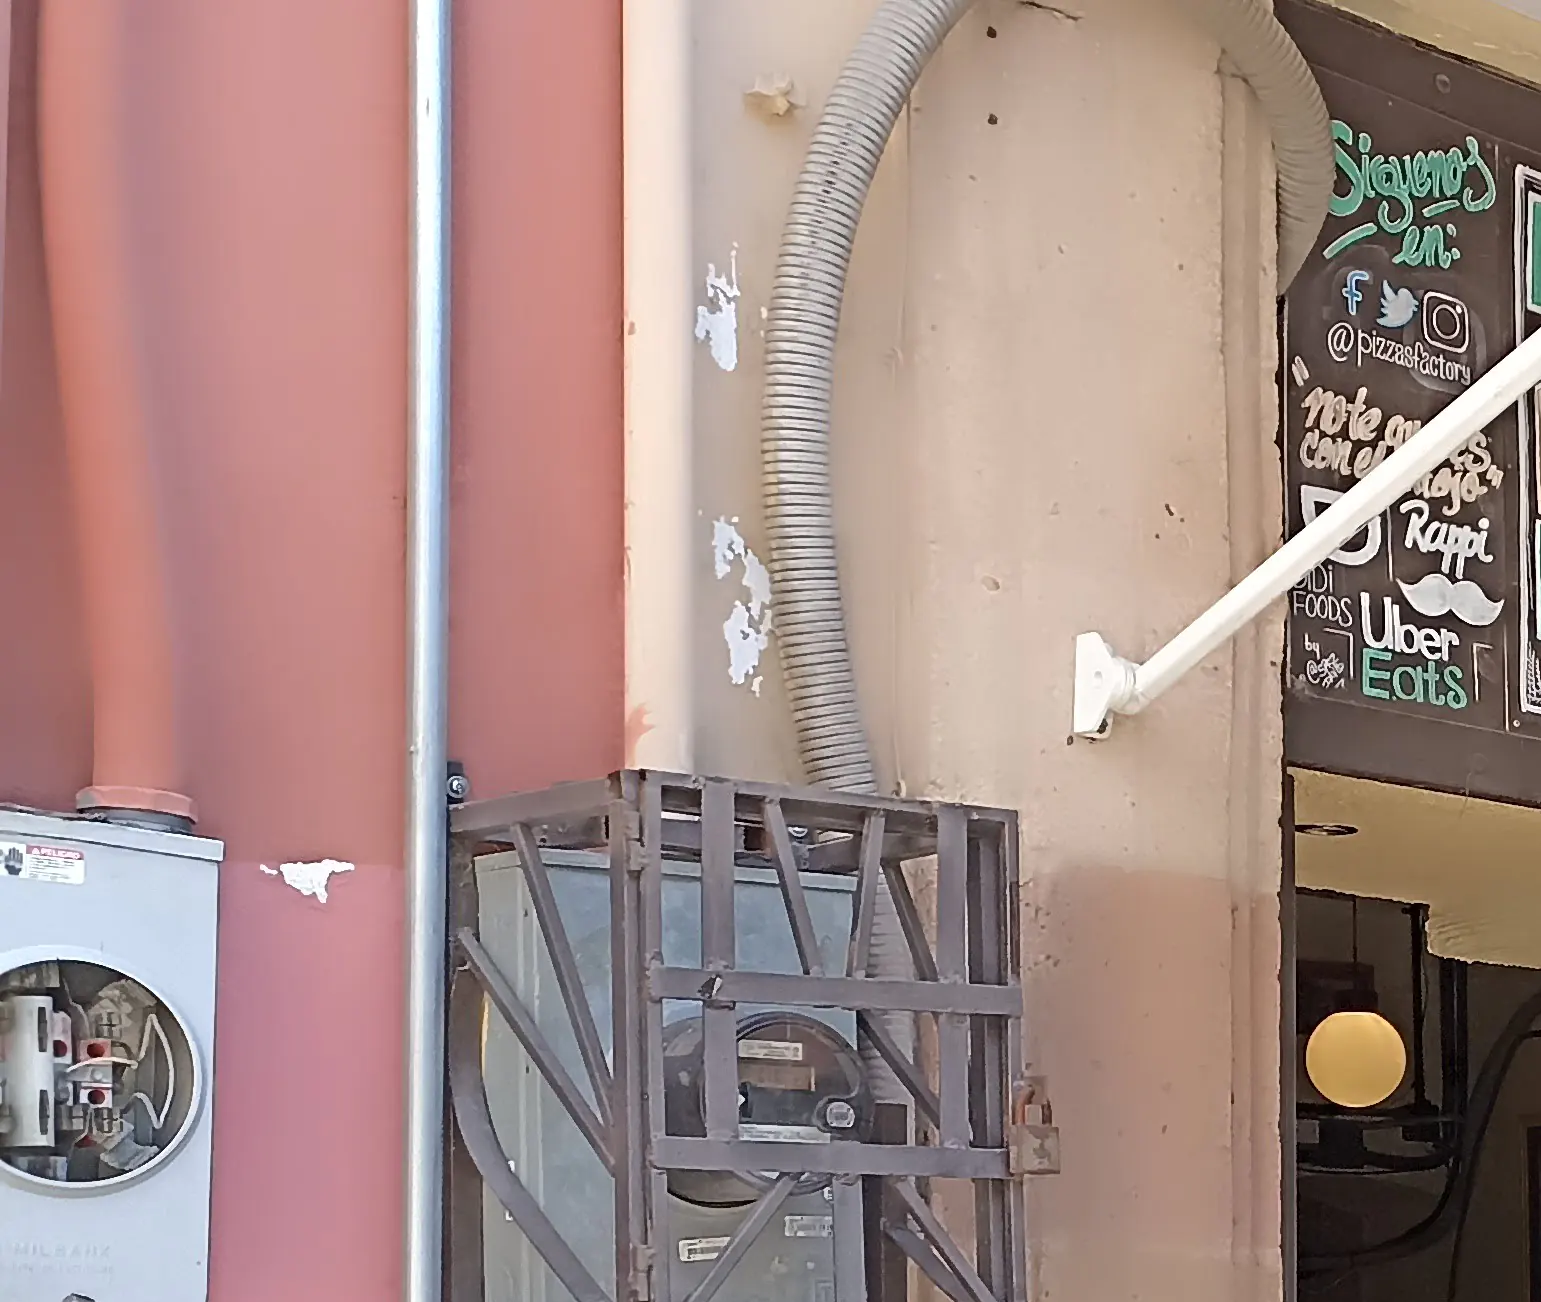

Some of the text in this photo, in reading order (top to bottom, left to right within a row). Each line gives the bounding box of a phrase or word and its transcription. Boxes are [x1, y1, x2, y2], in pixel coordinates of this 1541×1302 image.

[1327, 322, 1474, 387] @pizzasfactory
[1399, 498, 1495, 580] Rappi
[1292, 590, 1354, 628] FOODS
[1360, 591, 1461, 663] Uber
[1361, 648, 1469, 711] Eats
